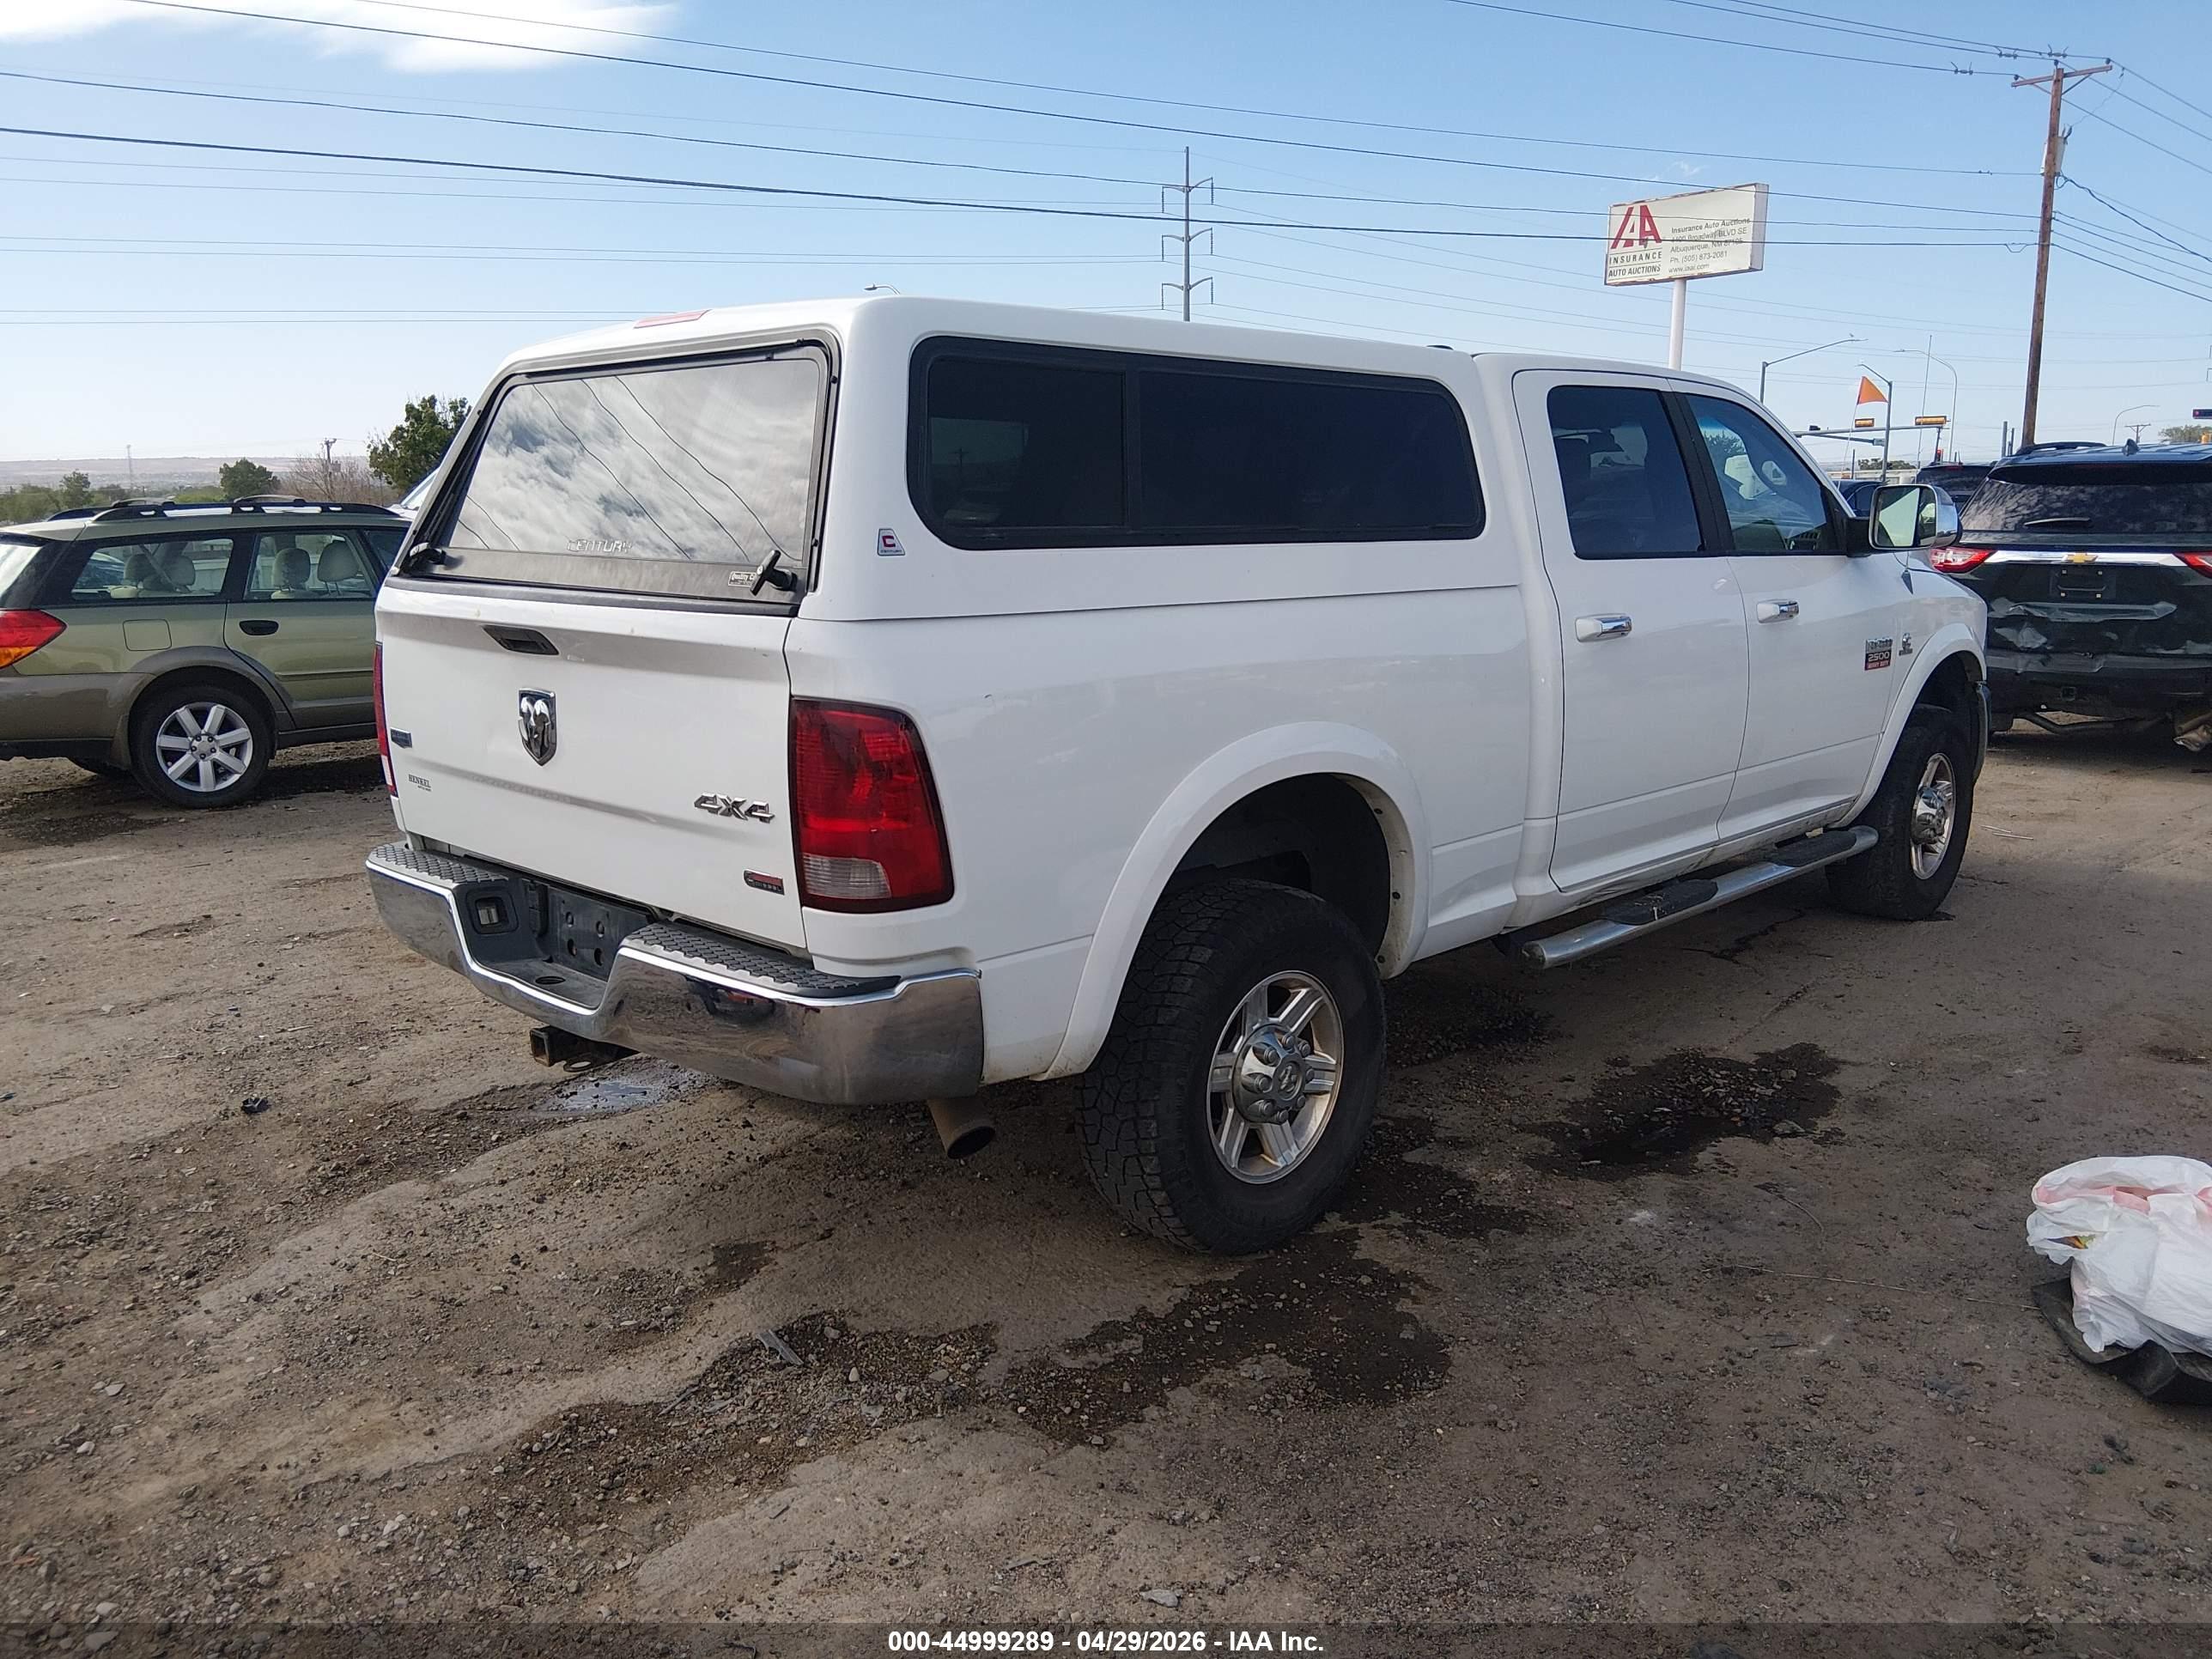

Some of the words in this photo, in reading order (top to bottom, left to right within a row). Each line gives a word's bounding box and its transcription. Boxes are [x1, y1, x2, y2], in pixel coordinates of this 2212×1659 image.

[1671, 224, 1703, 234] Insurance
[1721, 218, 1751, 227] Auctions
[1687, 232, 1717, 242] Broadway
[1609, 252, 1662, 264] INSURANCE
[1681, 254, 1698, 264] (505)
[1608, 269, 1626, 277] AUTO
[1628, 264, 1661, 276] AUCTIONS
[882, 535, 896, 548] C
[1869, 652, 1890, 662] 2500
